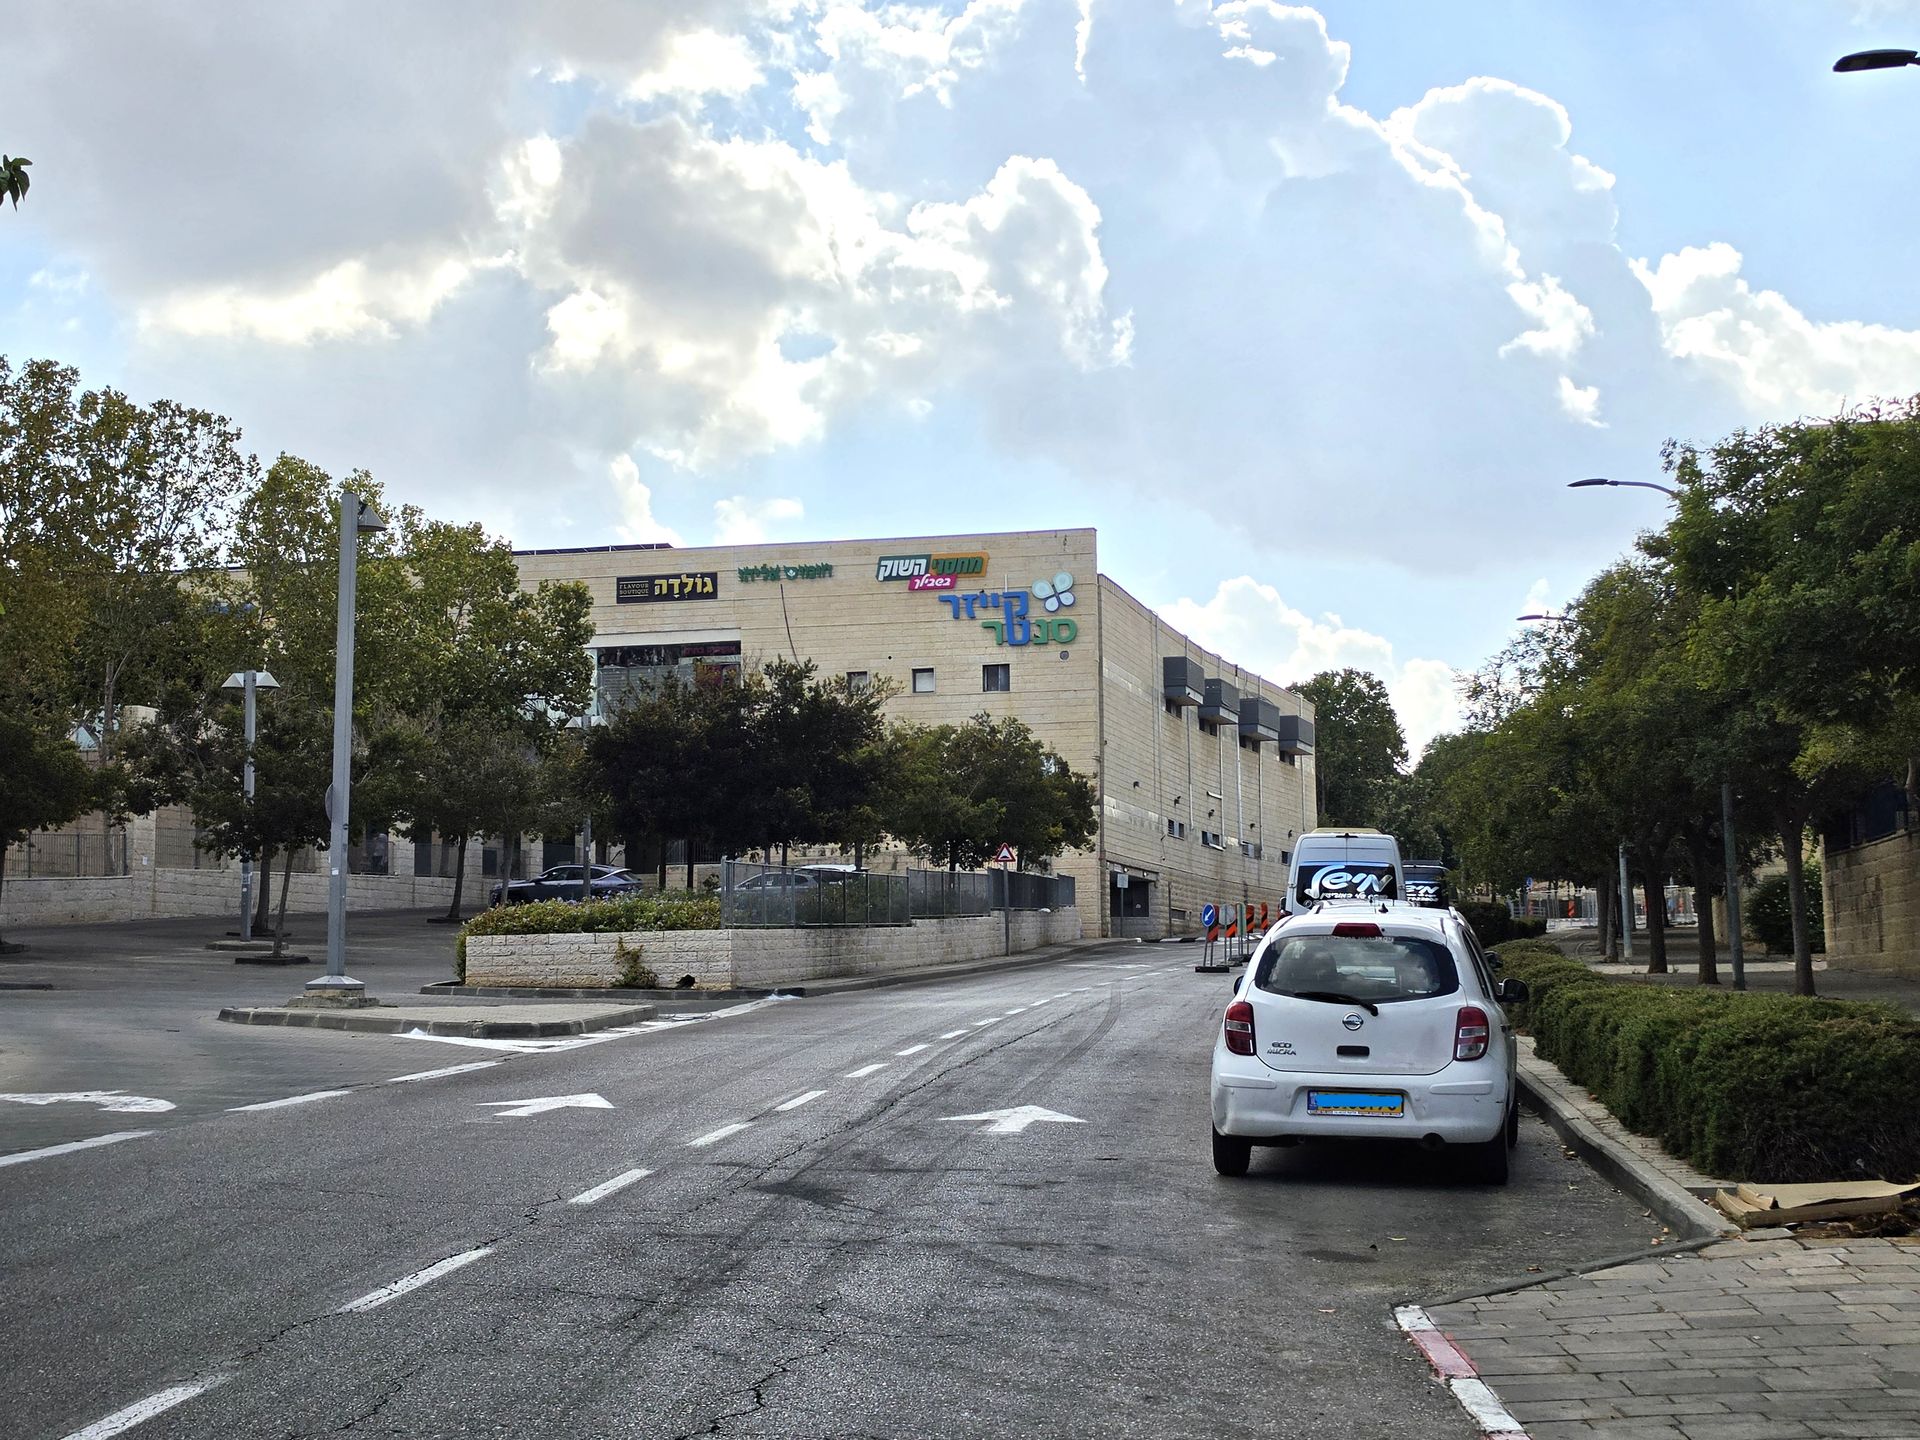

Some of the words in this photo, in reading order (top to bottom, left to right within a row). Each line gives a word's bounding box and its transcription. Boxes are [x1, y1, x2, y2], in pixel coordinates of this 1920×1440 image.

[878, 558, 927, 581] השוק
[931, 557, 984, 575] מחסני
[914, 574, 952, 589] בשבילך
[938, 591, 1029, 619] קייזר
[982, 618, 1077, 646] סנטר
